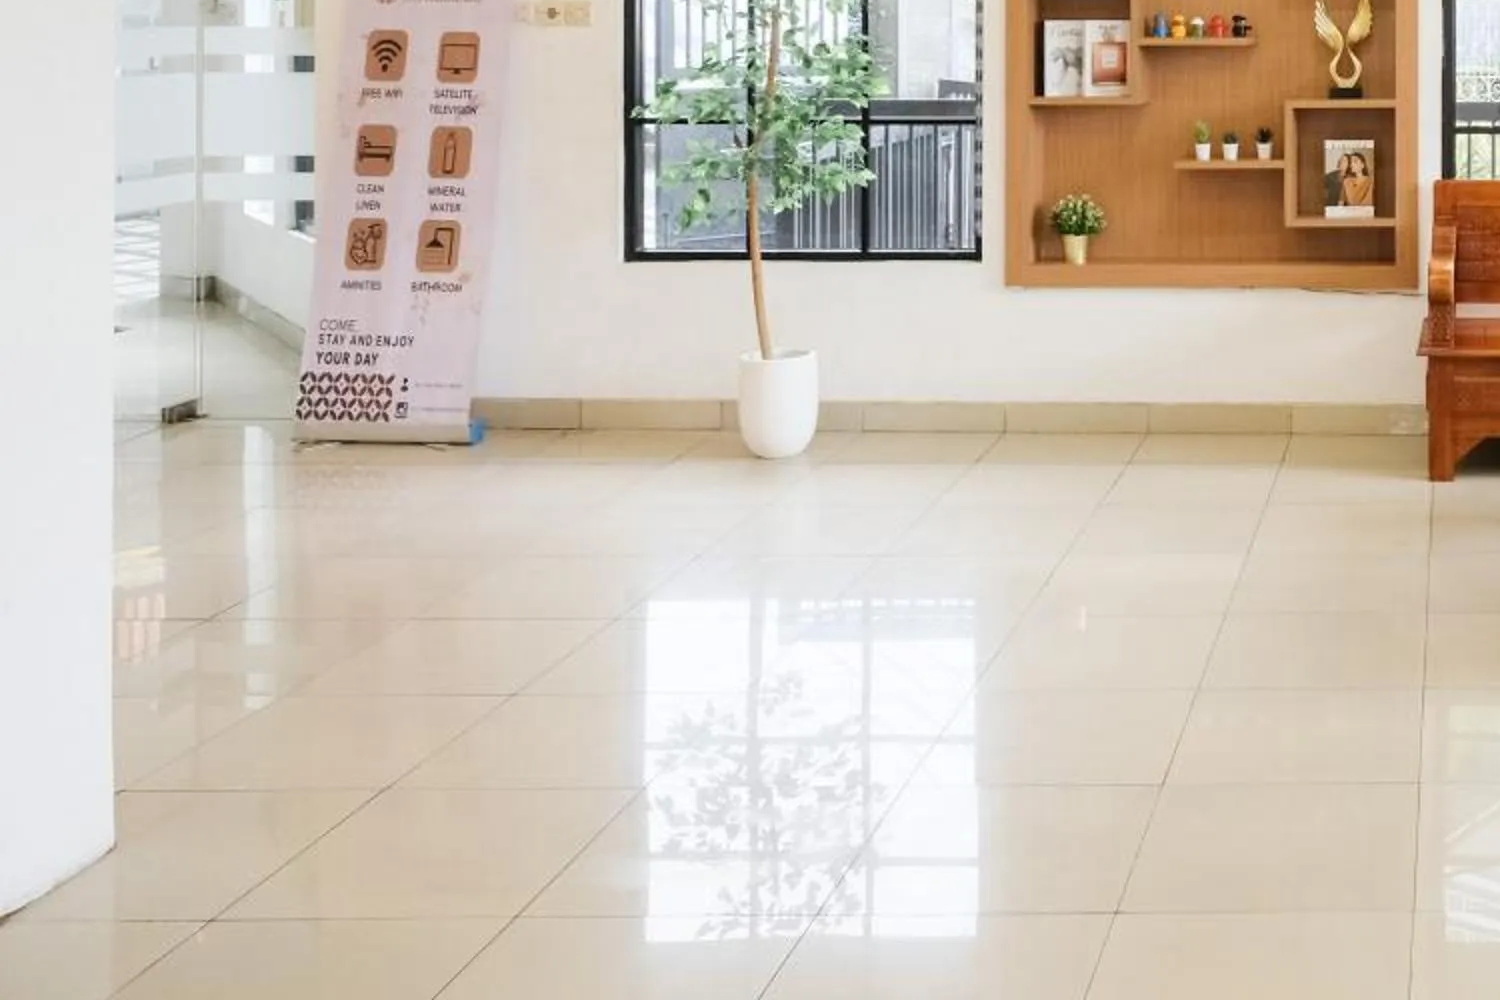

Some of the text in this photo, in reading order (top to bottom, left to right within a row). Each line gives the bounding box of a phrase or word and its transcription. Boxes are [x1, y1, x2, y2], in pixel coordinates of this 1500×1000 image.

[356, 184, 385, 195] CLEAN
[427, 186, 466, 197] MINERAL
[355, 200, 381, 212] LINEN
[429, 202, 462, 213] WATER
[410, 281, 463, 293] BATHROOM
[319, 318, 358, 331] COME
[318, 333, 415, 347] STAY AND ENJOY
[316, 351, 379, 366] YOUR DAY
